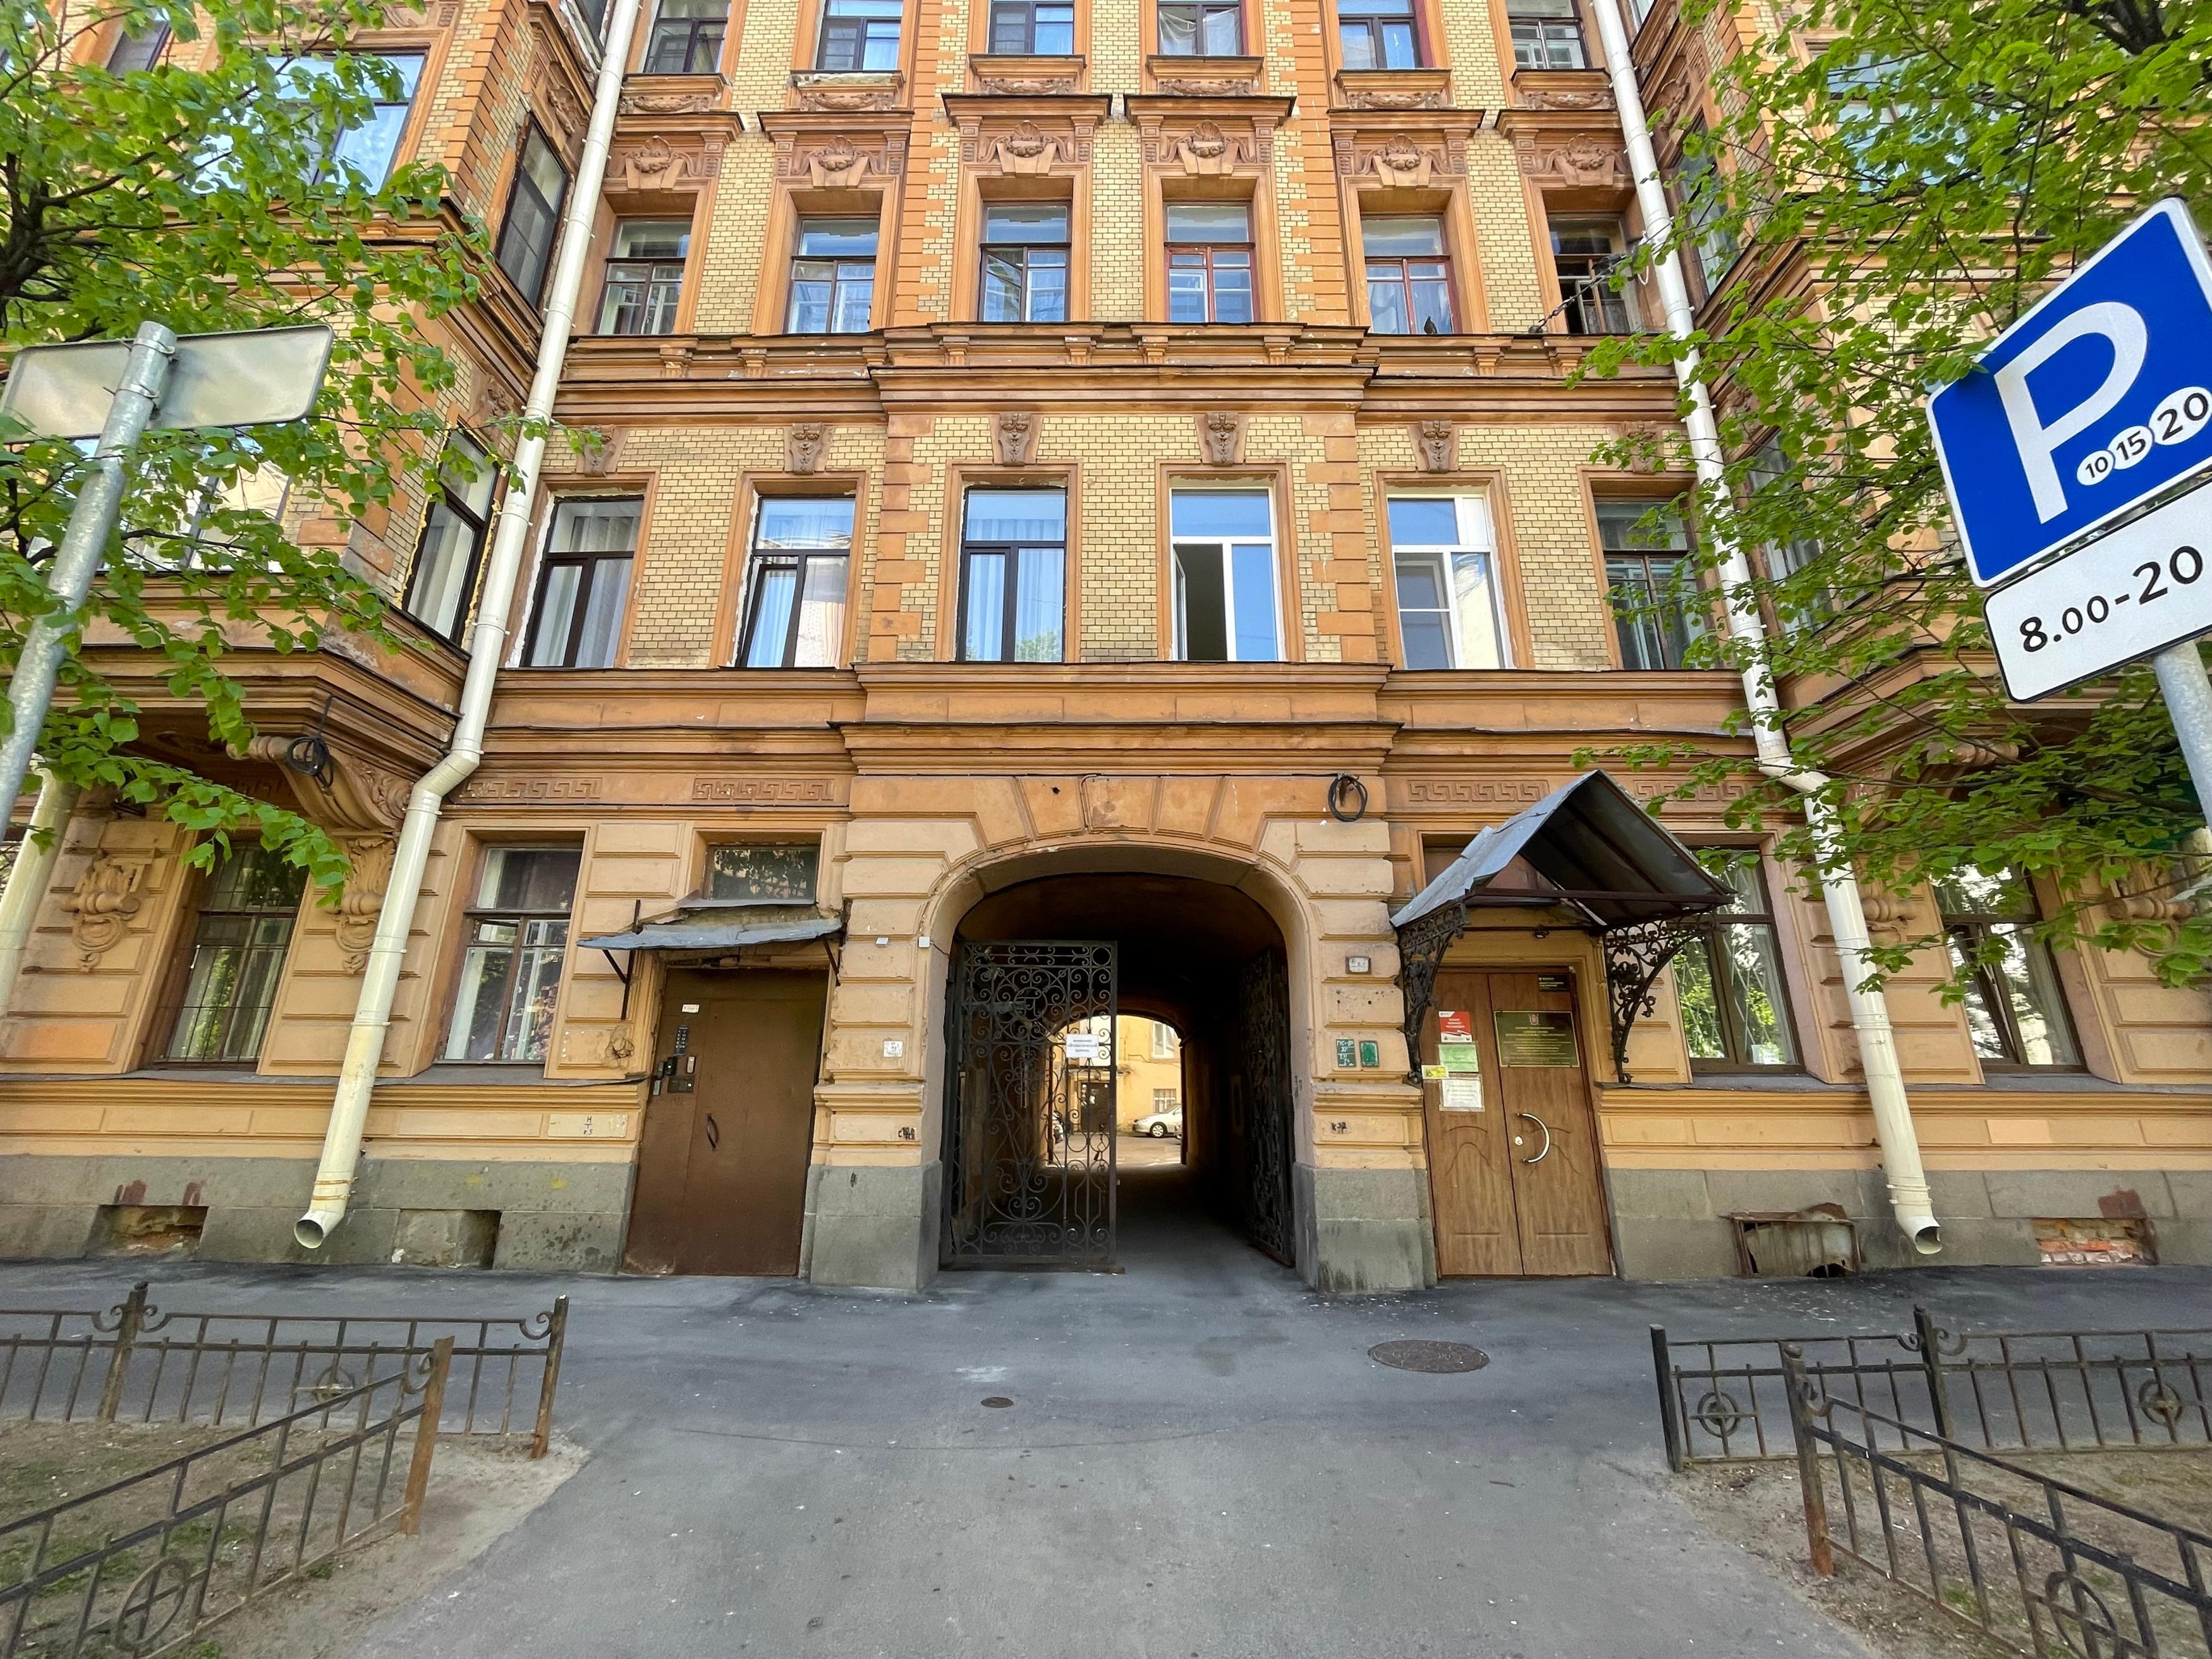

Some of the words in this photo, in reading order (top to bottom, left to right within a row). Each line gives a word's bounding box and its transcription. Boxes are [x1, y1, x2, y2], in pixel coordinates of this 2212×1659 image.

[1993, 301, 2148, 525] P
[2085, 456, 2108, 478] 10
[2116, 430, 2146, 461] 15
[2157, 392, 2209, 441] 20
[2019, 545, 2203, 652] 8.00-20
